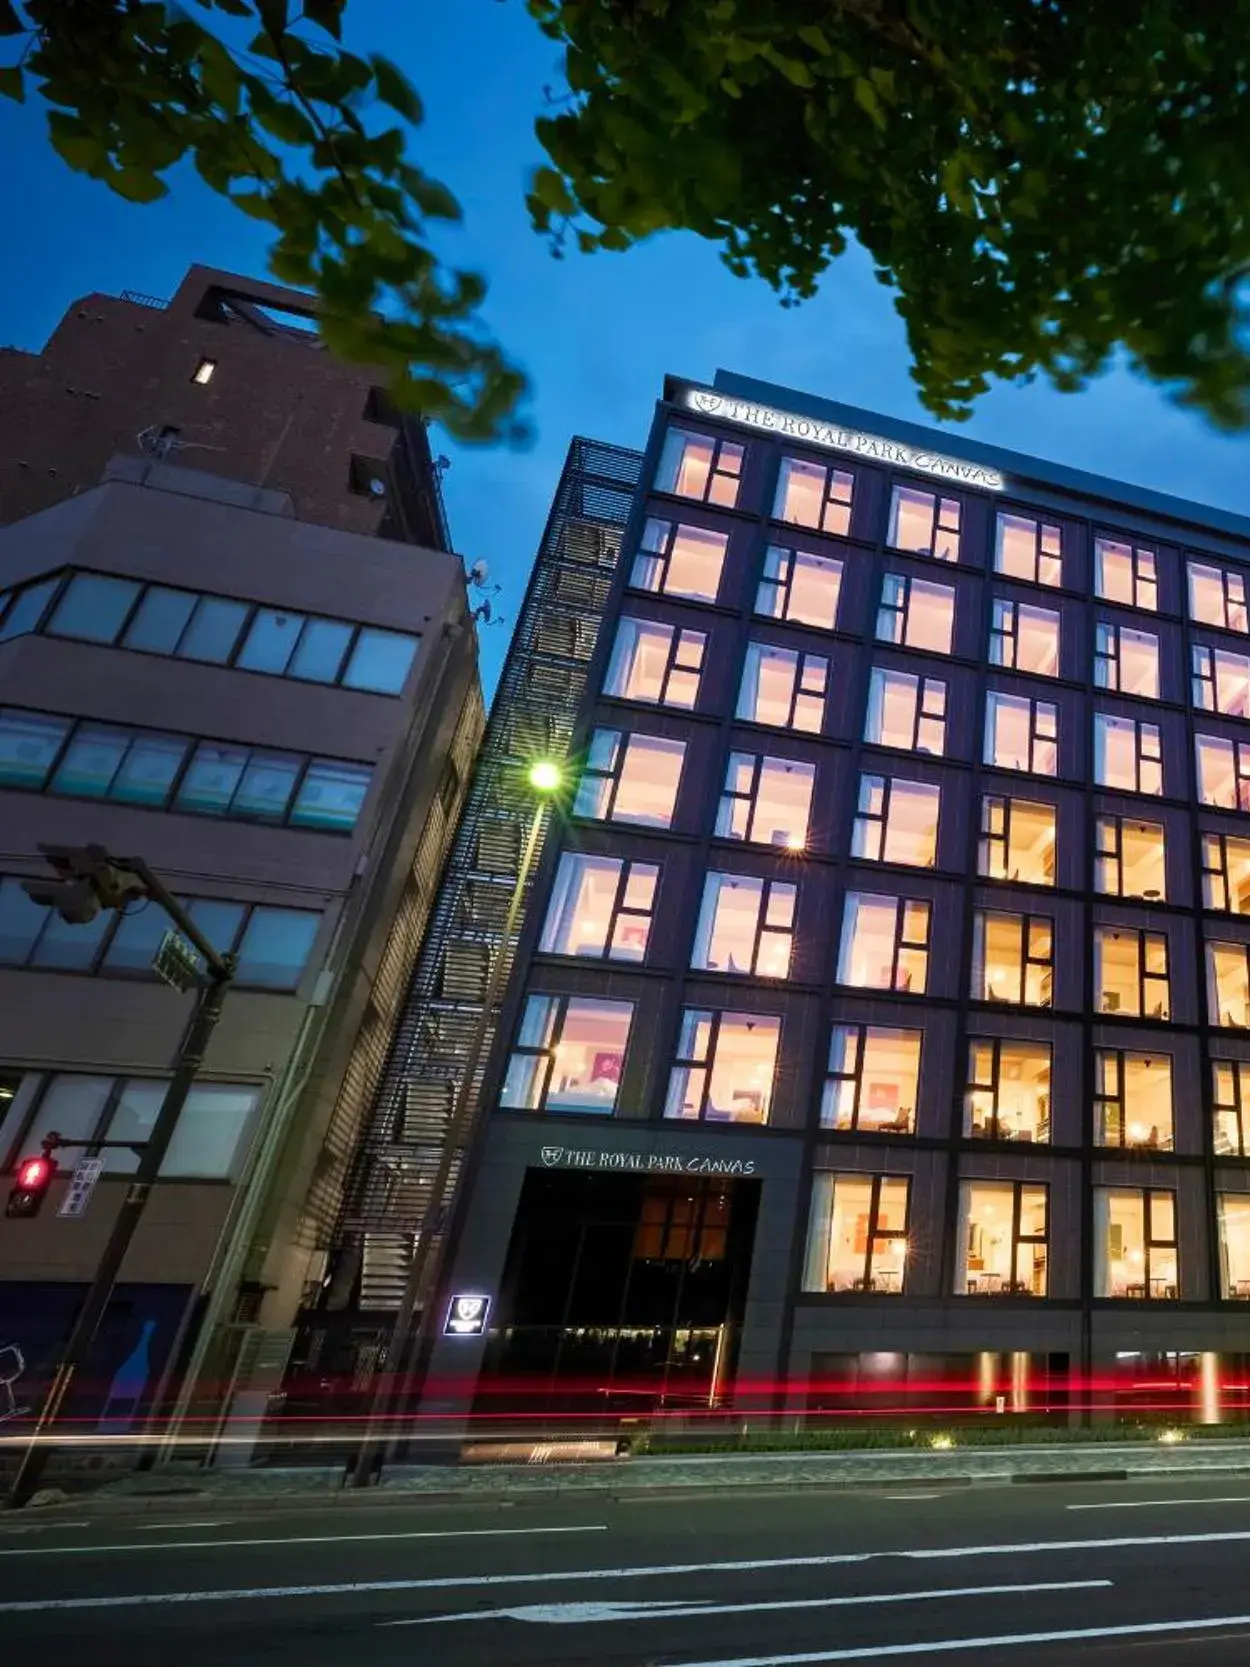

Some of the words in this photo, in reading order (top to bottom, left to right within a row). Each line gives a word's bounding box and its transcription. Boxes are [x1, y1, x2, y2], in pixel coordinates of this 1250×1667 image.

[728, 402, 775, 427] THE
[781, 417, 848, 448] ROYAL
[855, 436, 906, 463] PARK
[914, 454, 1000, 486] CANVAS
[566, 1150, 596, 1167] THE
[599, 1152, 644, 1169] ROYAL
[647, 1154, 683, 1171] PARK
[685, 1157, 755, 1175] CANVAS
